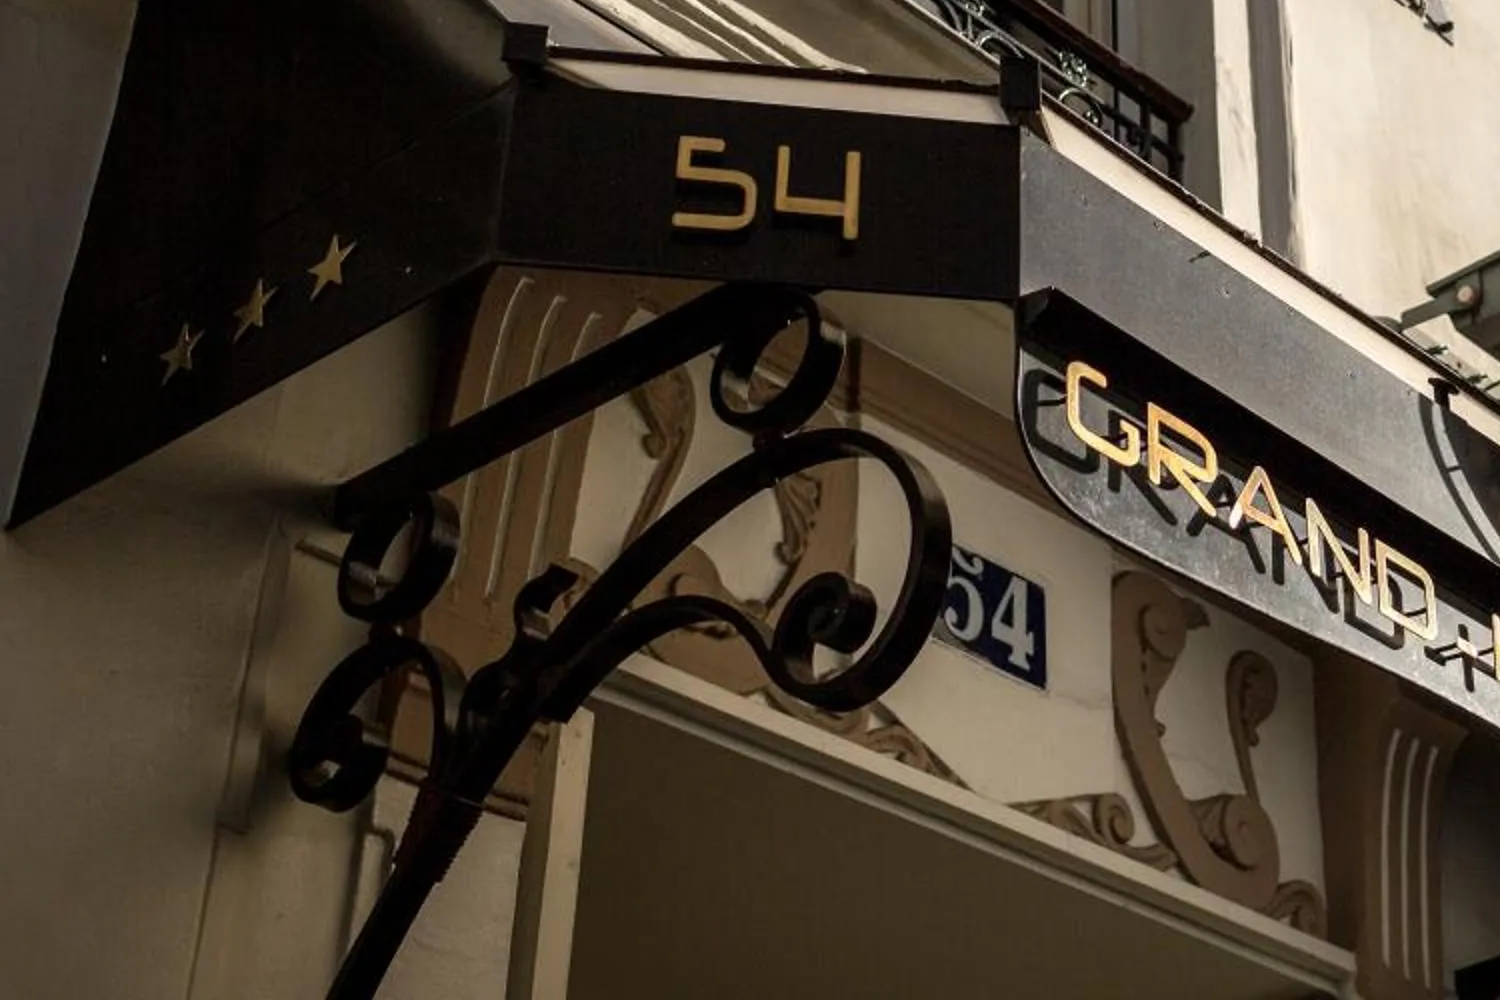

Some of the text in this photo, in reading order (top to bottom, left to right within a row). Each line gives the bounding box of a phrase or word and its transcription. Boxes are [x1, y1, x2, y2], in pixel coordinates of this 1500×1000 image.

[671, 135, 862, 241] 54
[1066, 360, 1438, 641] GRAND
[943, 546, 1034, 671] 54
